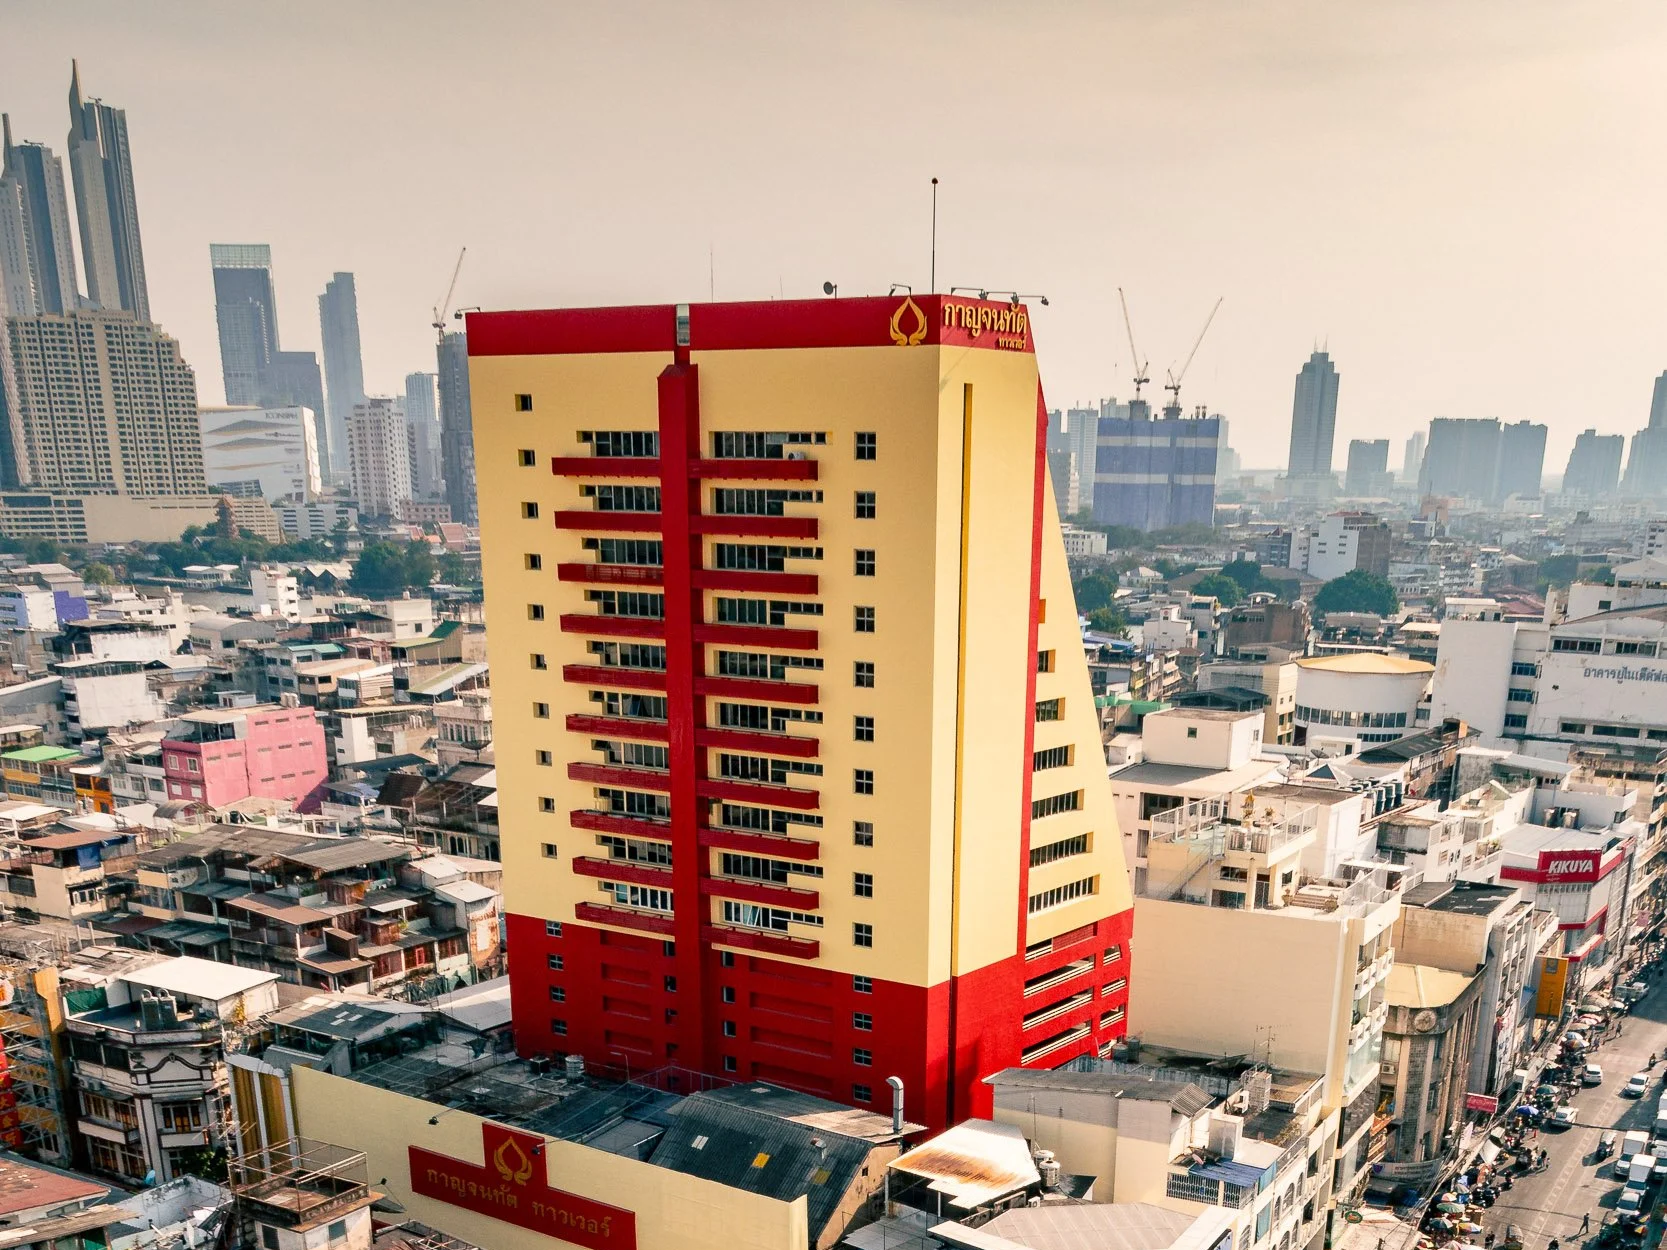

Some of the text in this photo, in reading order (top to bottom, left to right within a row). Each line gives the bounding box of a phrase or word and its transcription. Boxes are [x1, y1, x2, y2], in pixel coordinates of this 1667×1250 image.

[944, 303, 1027, 337] กาญจนทัต
[1548, 860, 1593, 874] KIKUYA
[427, 1167, 613, 1238] กาญจนทัต ทาวเวอร์
